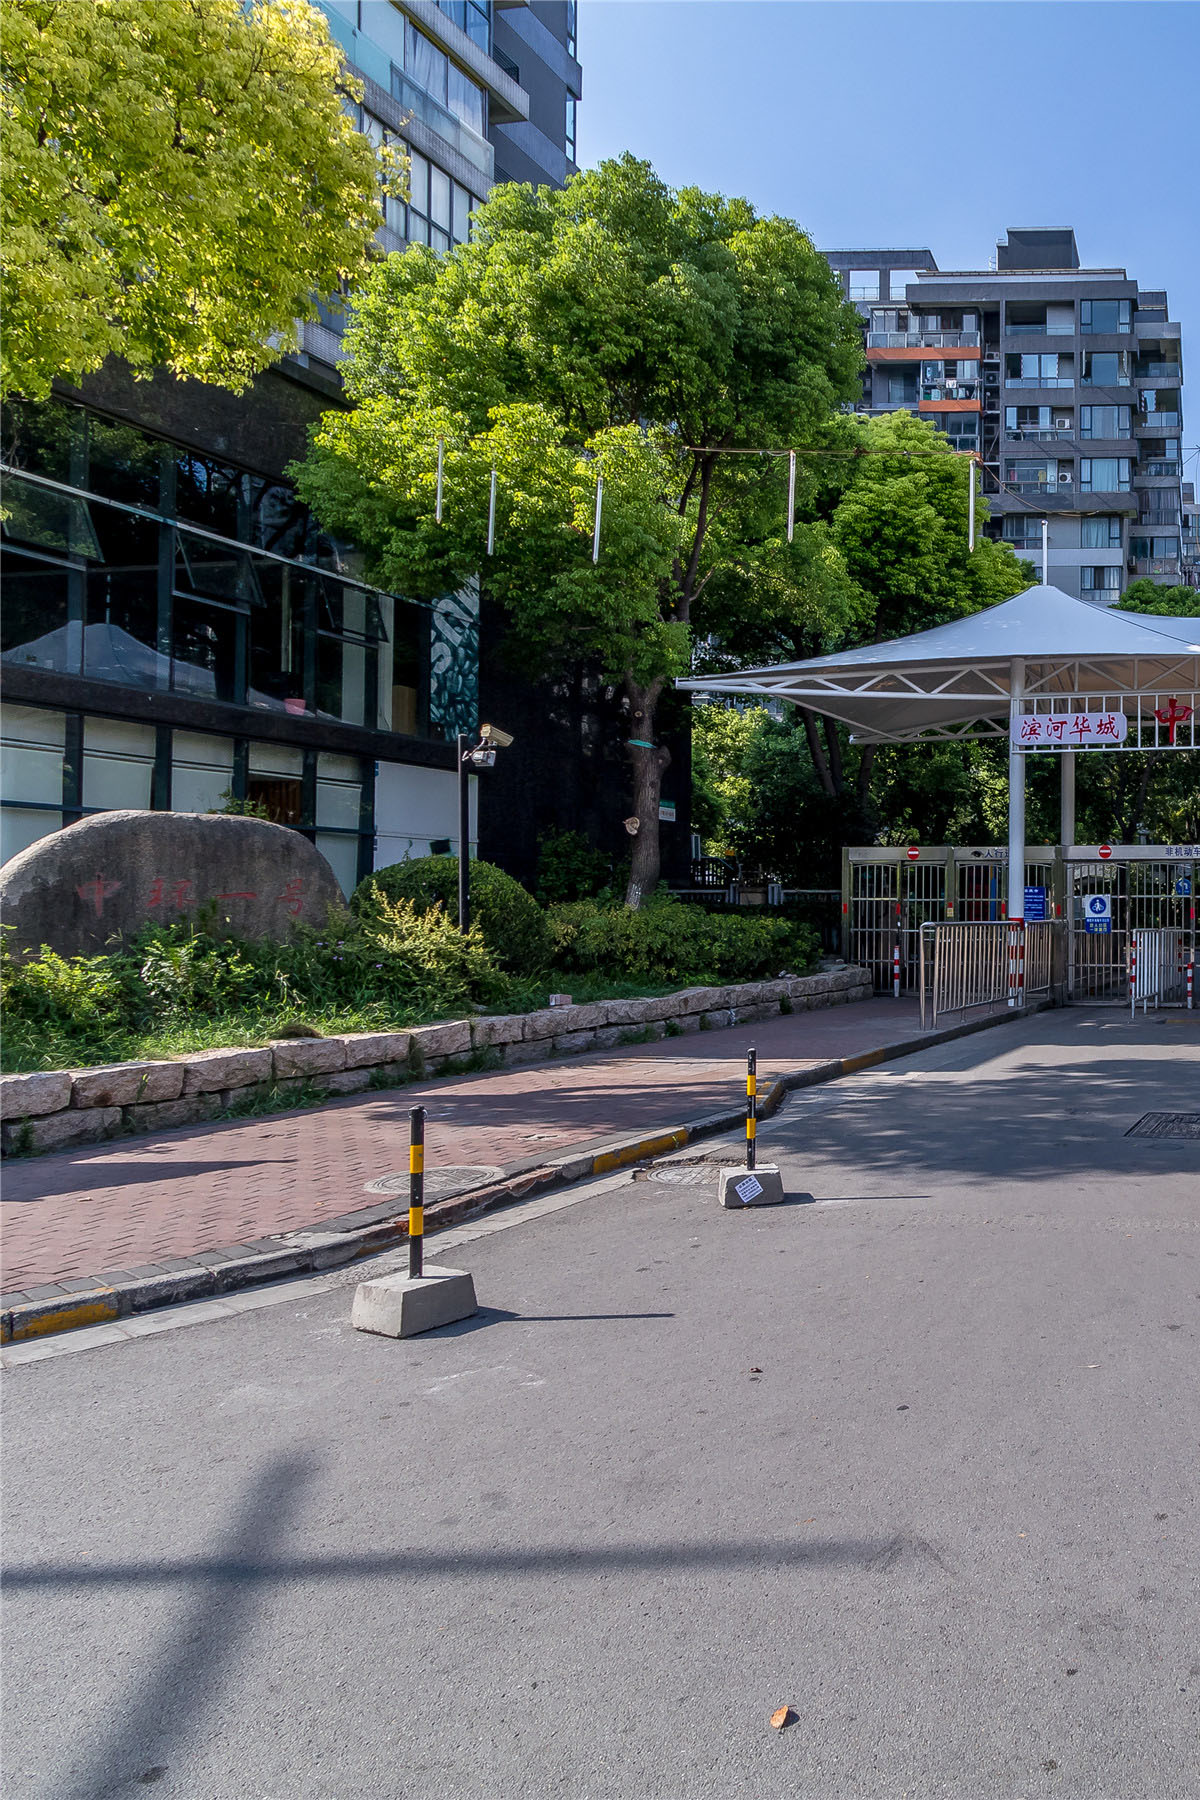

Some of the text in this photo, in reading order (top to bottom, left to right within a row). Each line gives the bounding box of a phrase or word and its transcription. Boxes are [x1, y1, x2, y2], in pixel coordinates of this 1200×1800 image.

[1020, 714, 1120, 743] 滨河华城
[76, 872, 309, 919] 中环一号
